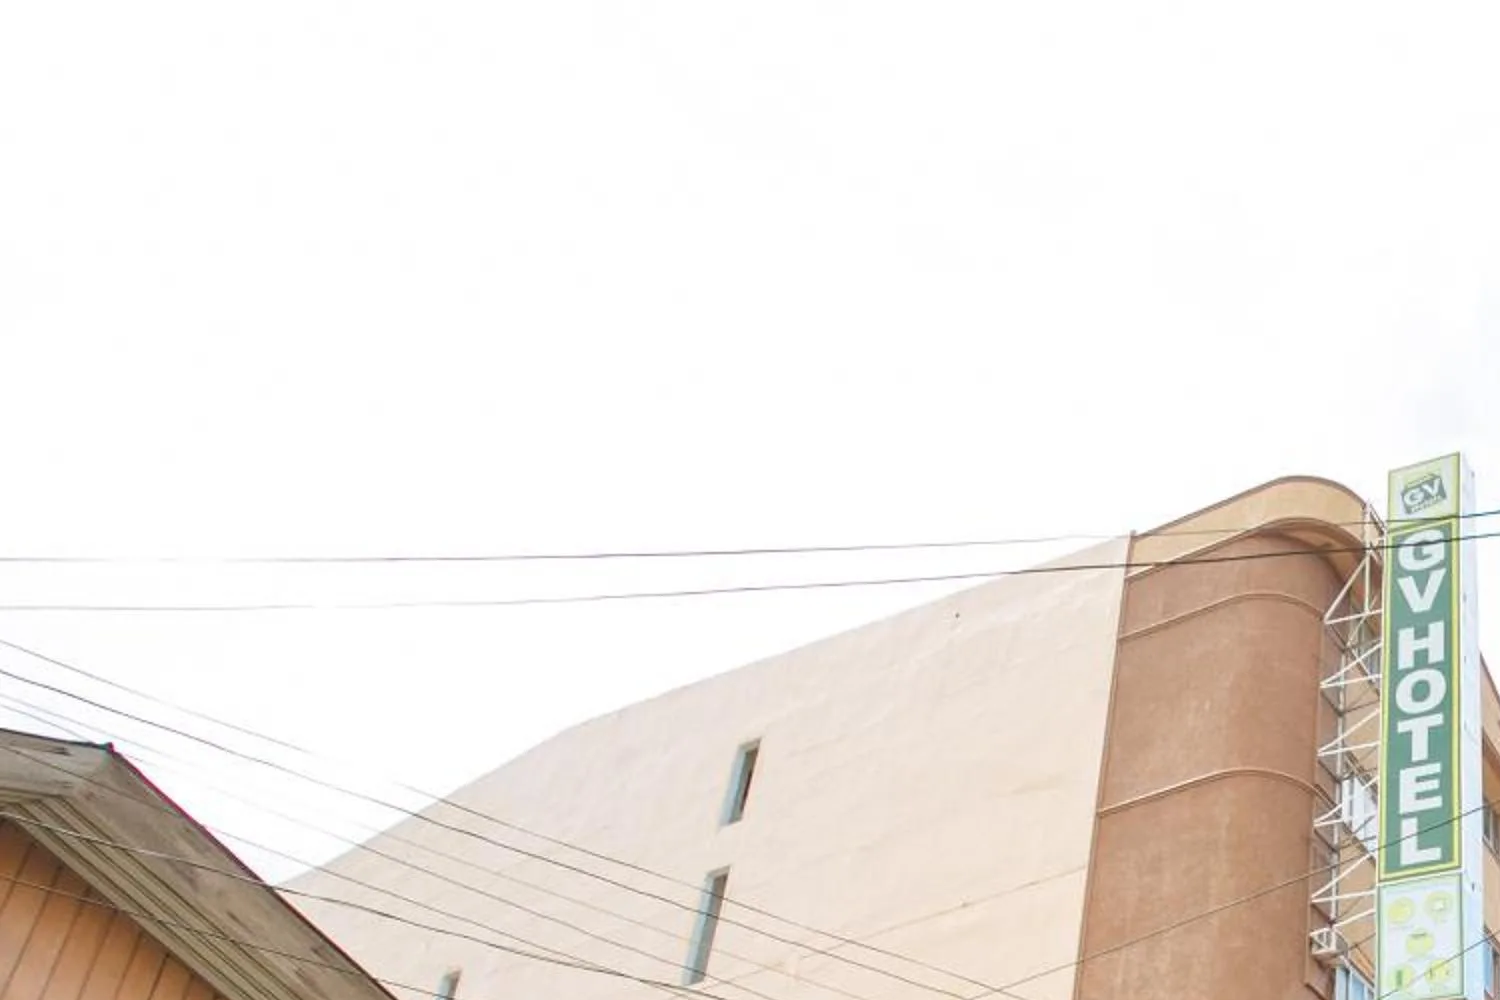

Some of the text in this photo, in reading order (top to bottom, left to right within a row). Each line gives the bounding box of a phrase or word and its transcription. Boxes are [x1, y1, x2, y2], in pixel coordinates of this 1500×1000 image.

[1403, 478, 1442, 506] GV
[1397, 529, 1446, 614] GV
[1395, 621, 1447, 867] HOTEL
